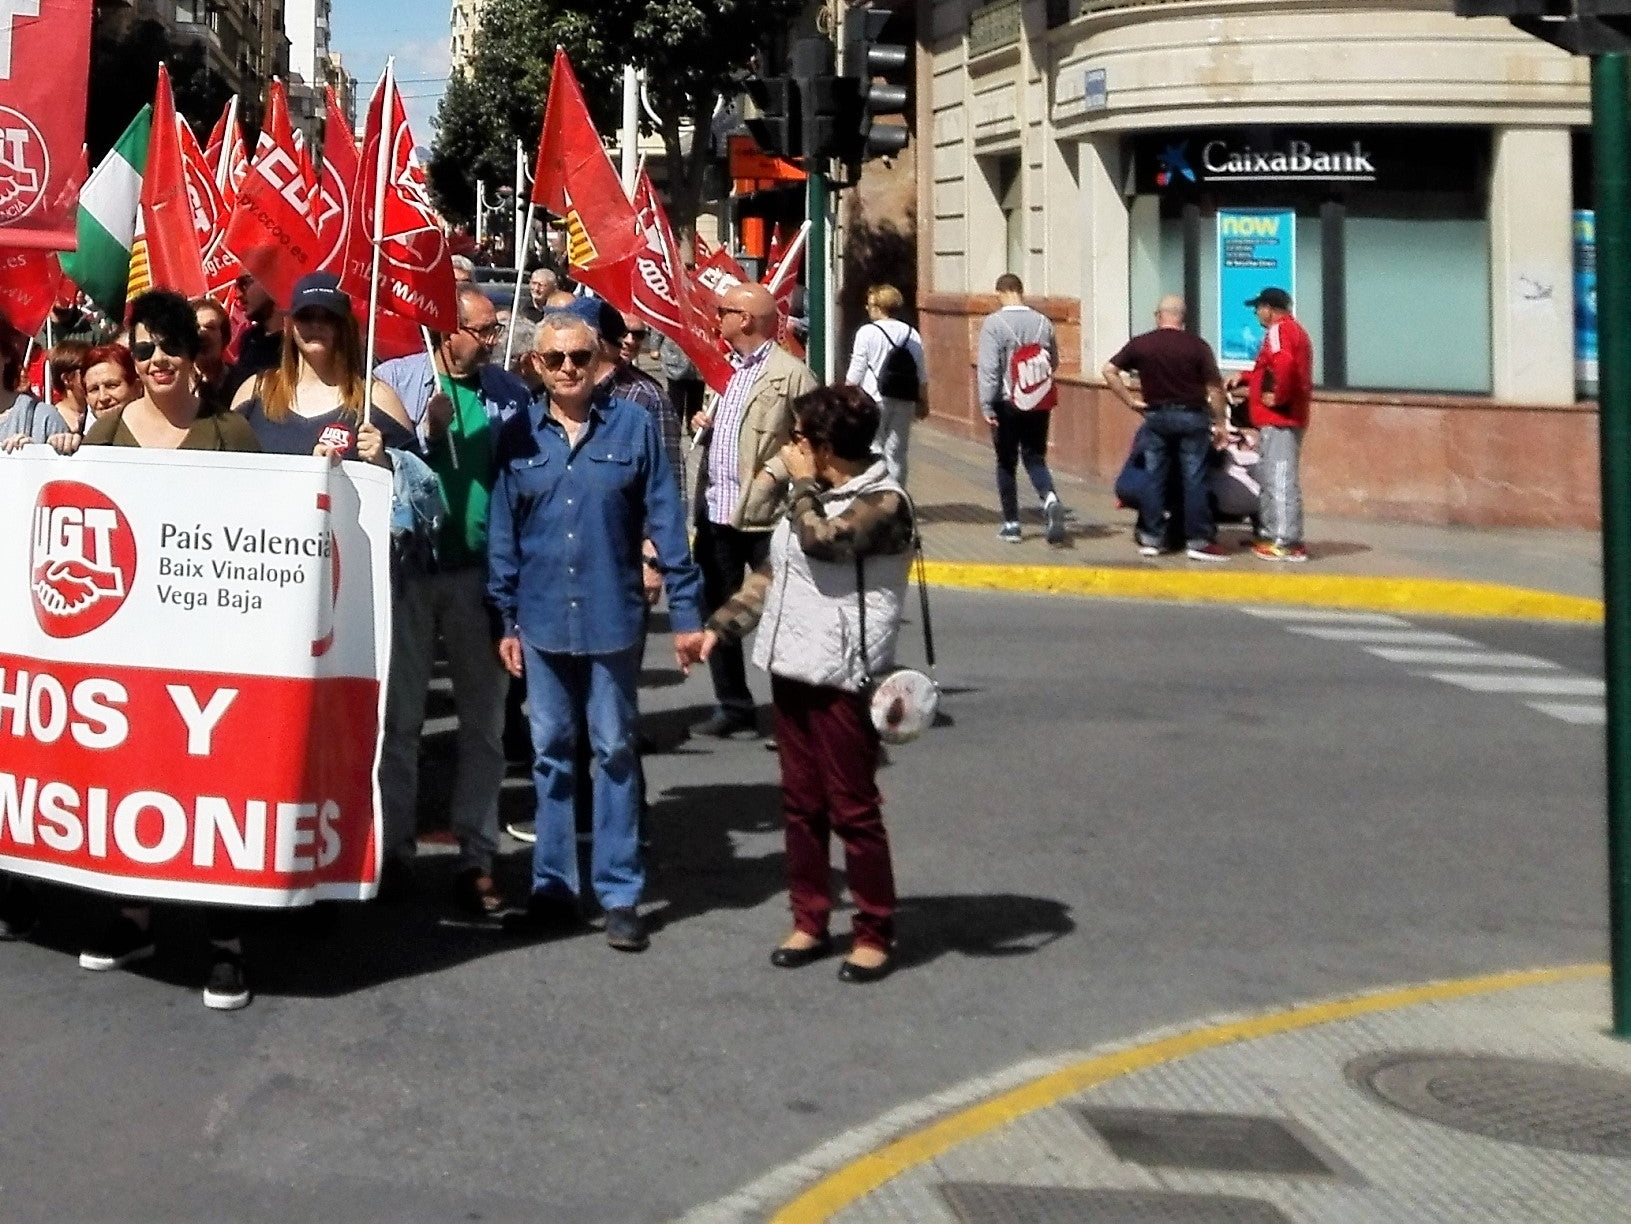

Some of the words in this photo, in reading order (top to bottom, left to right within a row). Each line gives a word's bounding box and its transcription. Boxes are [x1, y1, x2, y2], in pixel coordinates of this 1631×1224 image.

[1202, 140, 1375, 173] CaixaBank
[1222, 216, 1280, 237] now
[33, 506, 118, 570] UGT
[160, 523, 213, 551] País
[158, 556, 204, 579] Baix
[211, 559, 305, 588] Vinalopó
[156, 584, 208, 611] Vega
[217, 588, 263, 614] Baja
[167, 684, 240, 756] Y
